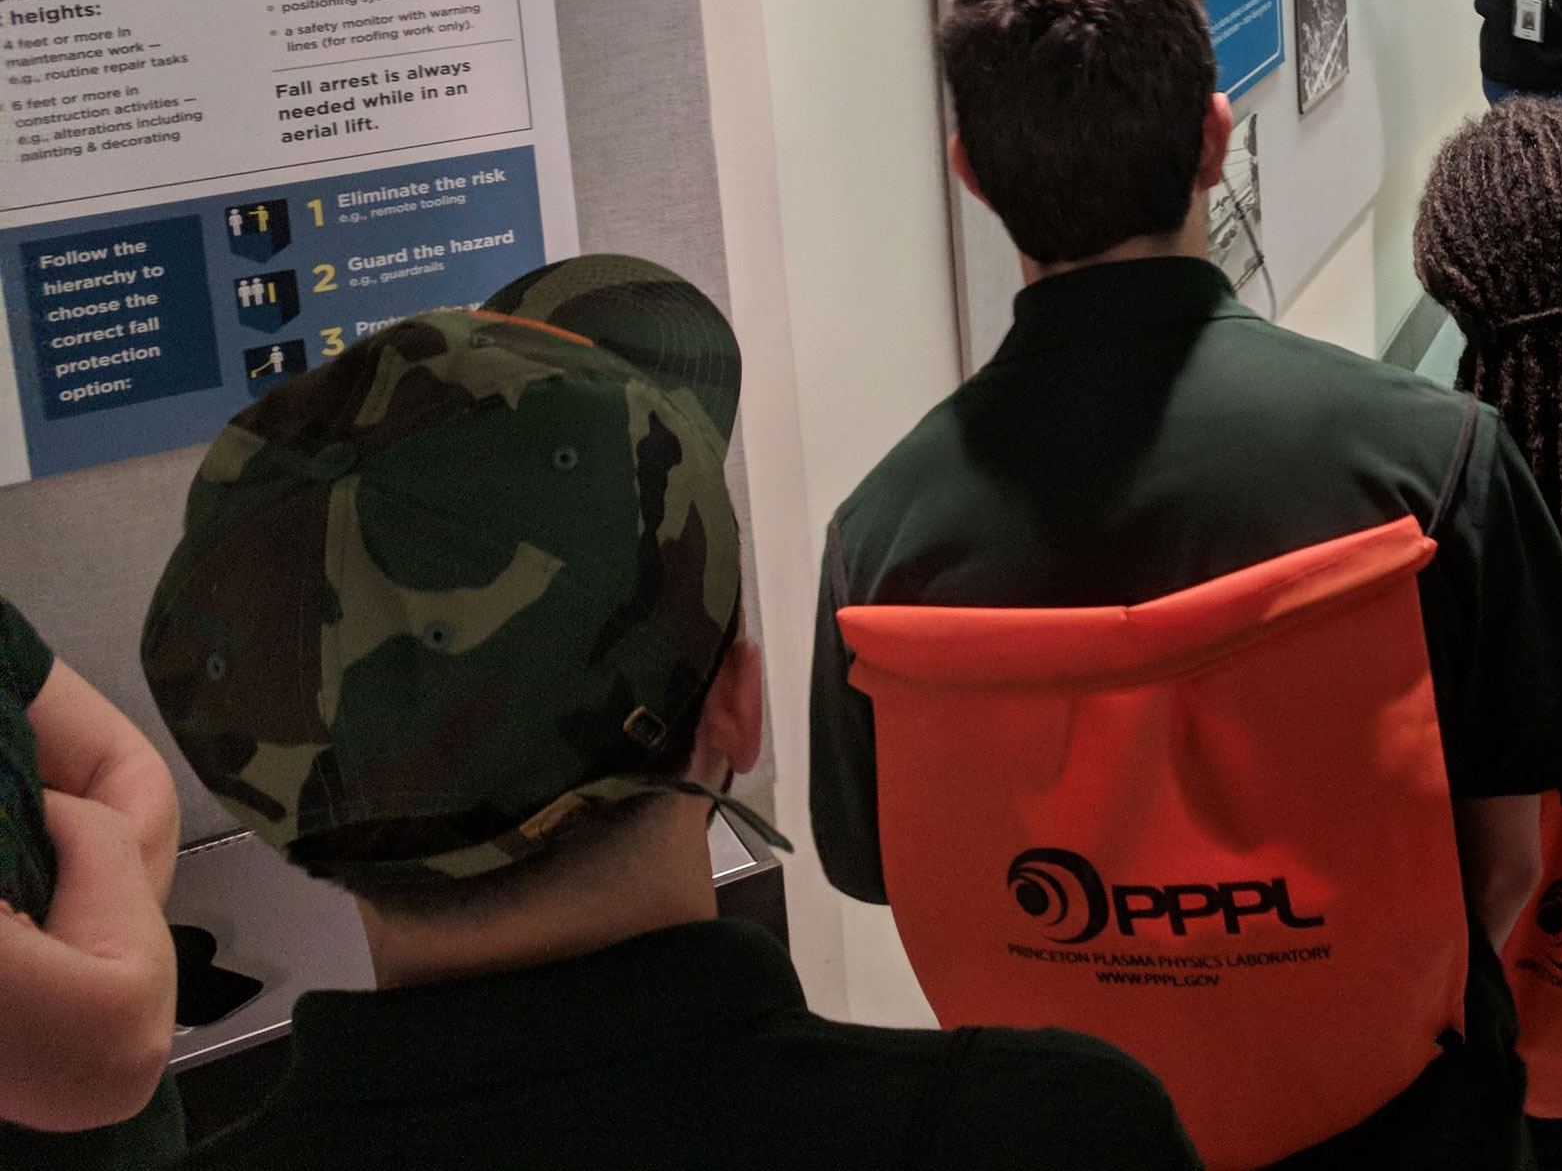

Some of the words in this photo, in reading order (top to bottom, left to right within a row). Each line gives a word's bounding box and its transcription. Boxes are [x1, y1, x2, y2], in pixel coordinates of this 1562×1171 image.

[10, 3, 102, 25] heights:
[285, 27, 293, 37] a
[297, 20, 338, 35] safety
[342, 14, 395, 30] monitor
[398, 10, 426, 23] with
[429, 3, 481, 20] warning
[18, 37, 49, 49] feet
[53, 35, 70, 45] or
[74, 31, 113, 43] more
[117, 27, 132, 38] in
[287, 39, 319, 52] lines
[322, 34, 346, 49] (for
[350, 28, 399, 45] roofing
[402, 23, 435, 37] work
[5, 49, 104, 67] maintenance
[108, 42, 145, 56] work
[45, 64, 99, 81] routine
[103, 58, 147, 74] repair
[151, 52, 190, 68] tasks
[275, 80, 312, 99] Fall
[319, 72, 379, 92] arrest
[384, 69, 400, 83] is
[406, 60, 472, 81] always
[27, 97, 57, 109] feet
[61, 95, 77, 106] or
[82, 88, 122, 102] more
[126, 85, 139, 96] in
[278, 97, 356, 121] needed
[362, 89, 415, 109] while
[420, 86, 438, 100] in
[445, 83, 468, 96] an
[15, 107, 110, 128] construction
[114, 97, 179, 115] activities
[53, 122, 133, 140] alterations
[137, 110, 203, 128] including
[281, 121, 338, 143] aerial
[345, 117, 379, 134] lift.
[20, 145, 82, 162] painting
[101, 130, 181, 150] decorating
[307, 199, 325, 227] 1
[337, 183, 430, 208] Eliminate
[434, 175, 467, 192] the
[471, 167, 507, 186] risk
[370, 202, 418, 218] remote
[420, 194, 467, 209] tooling
[39, 247, 108, 269] Follow
[113, 241, 147, 257] the
[312, 263, 338, 294] 2
[347, 247, 408, 271] Guard
[413, 244, 445, 260] the
[450, 229, 515, 254] hazard
[43, 269, 137, 296] hierarchy
[142, 265, 164, 279] to
[379, 260, 446, 283] guardrails
[48, 300, 120, 322] choose
[125, 293, 159, 309] the
[51, 324, 125, 349] correct
[128, 316, 160, 335] fall
[320, 326, 346, 357] 3
[55, 344, 162, 378] protection
[59, 378, 132, 402] option:
[1111, 878, 1325, 936] PPPL
[1007, 943, 1090, 964] PRINCETON
[1093, 952, 1155, 968] PLASMA
[1159, 954, 1222, 969] PHYSICS
[1226, 944, 1331, 968] LABORATORY
[1095, 971, 1220, 988] WWW.PPPL.GOV
